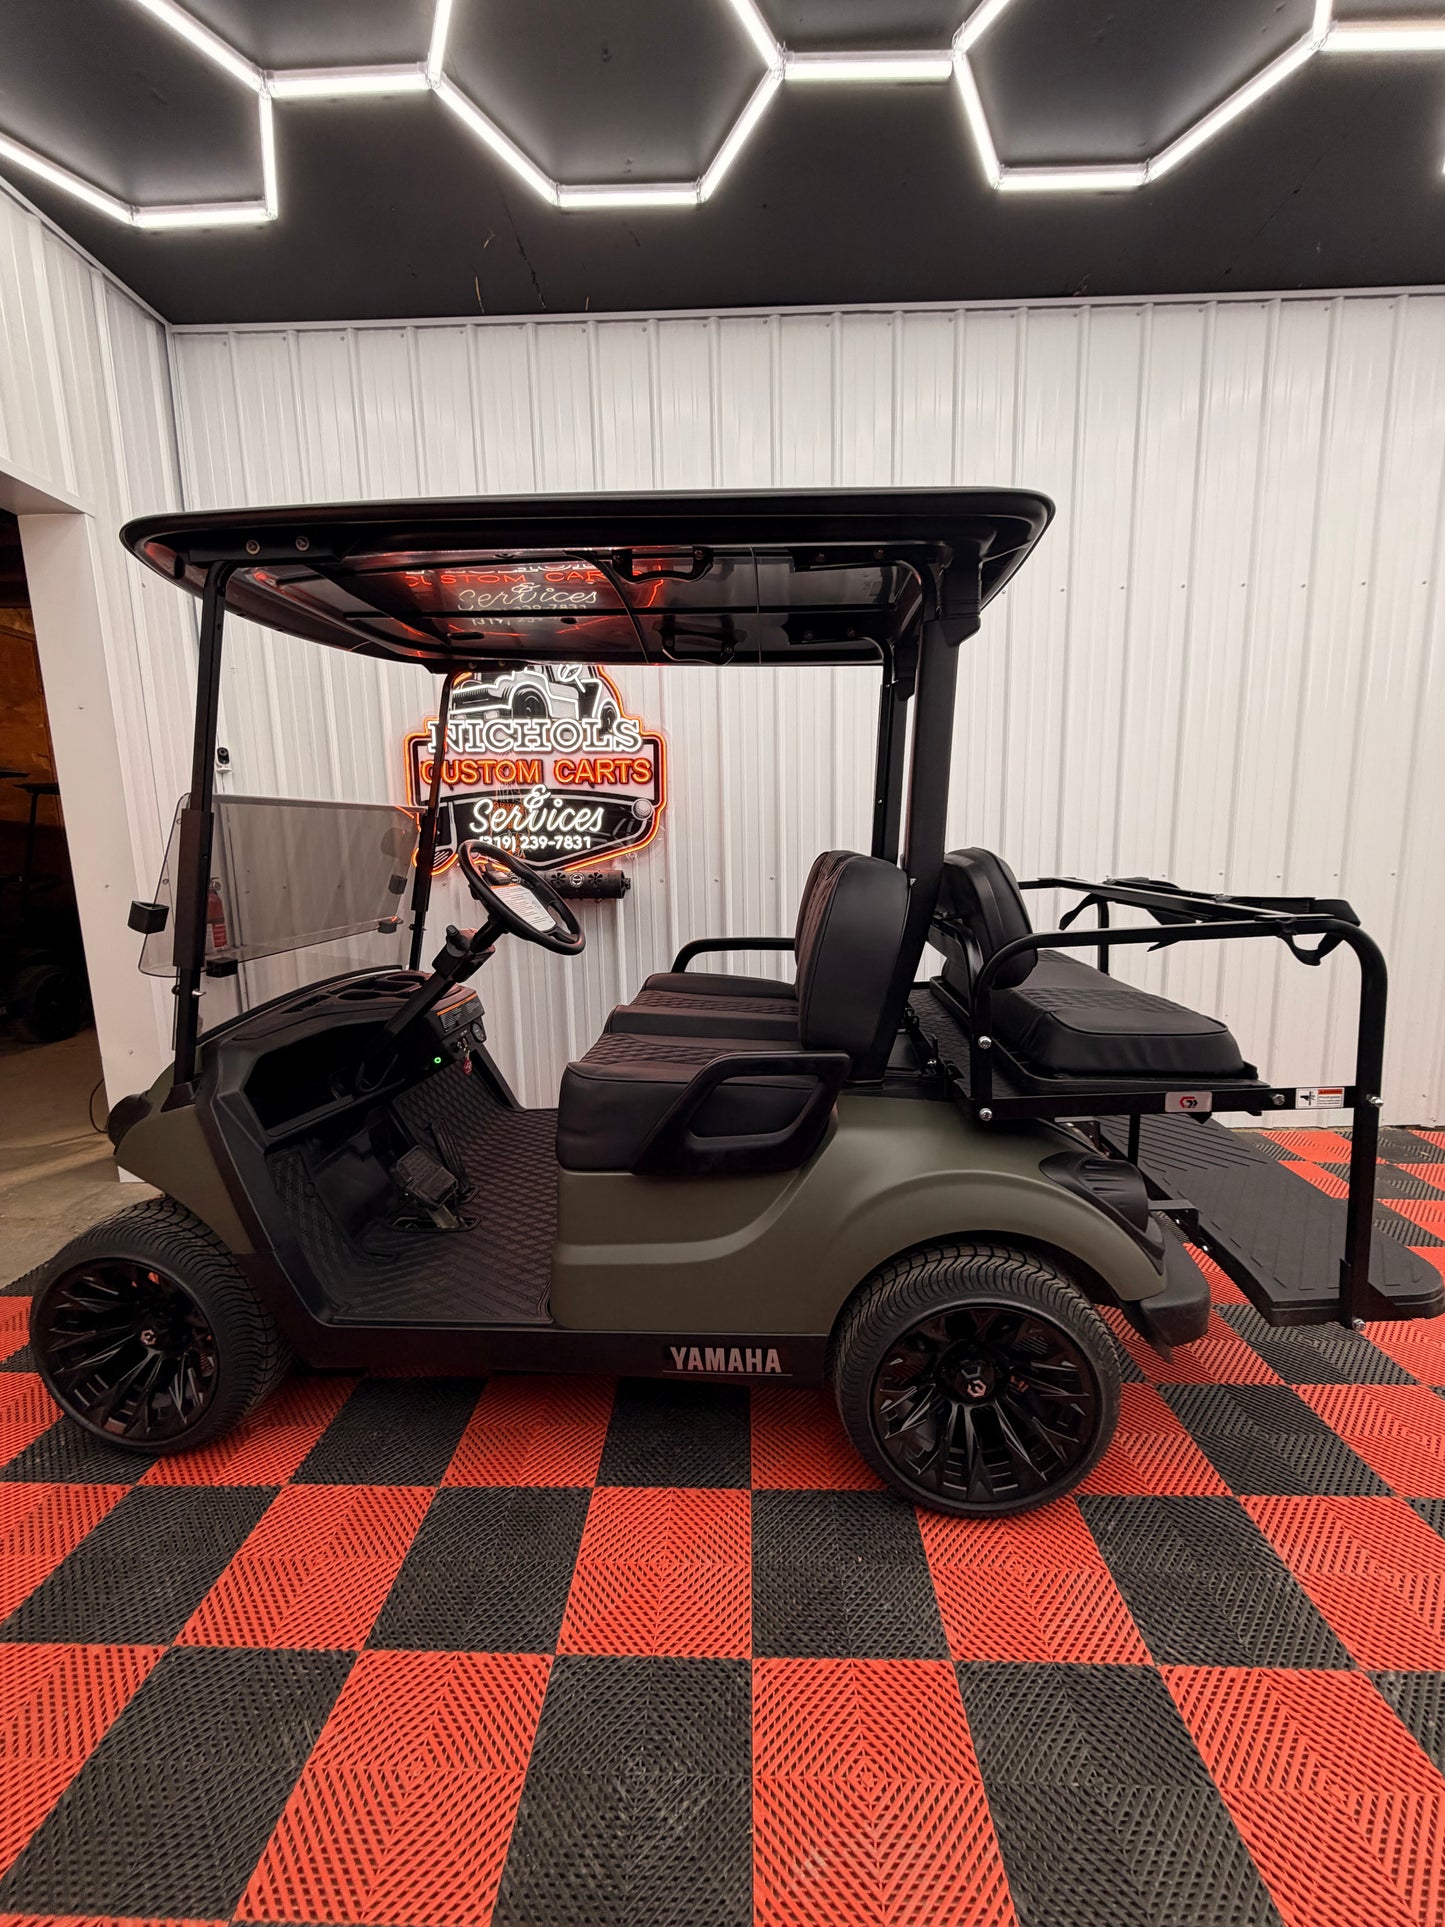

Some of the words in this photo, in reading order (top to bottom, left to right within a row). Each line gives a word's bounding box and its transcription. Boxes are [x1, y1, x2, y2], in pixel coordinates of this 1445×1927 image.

[458, 588, 598, 611] Services
[427, 719, 643, 753] NICHOLS
[421, 758, 544, 785] CUSTOM
[553, 757, 653, 785] CARTS
[523, 784, 551, 810] &
[469, 798, 605, 833] Services
[519, 835, 592, 850] 239-7831
[669, 1346, 782, 1373] YAMAHA
